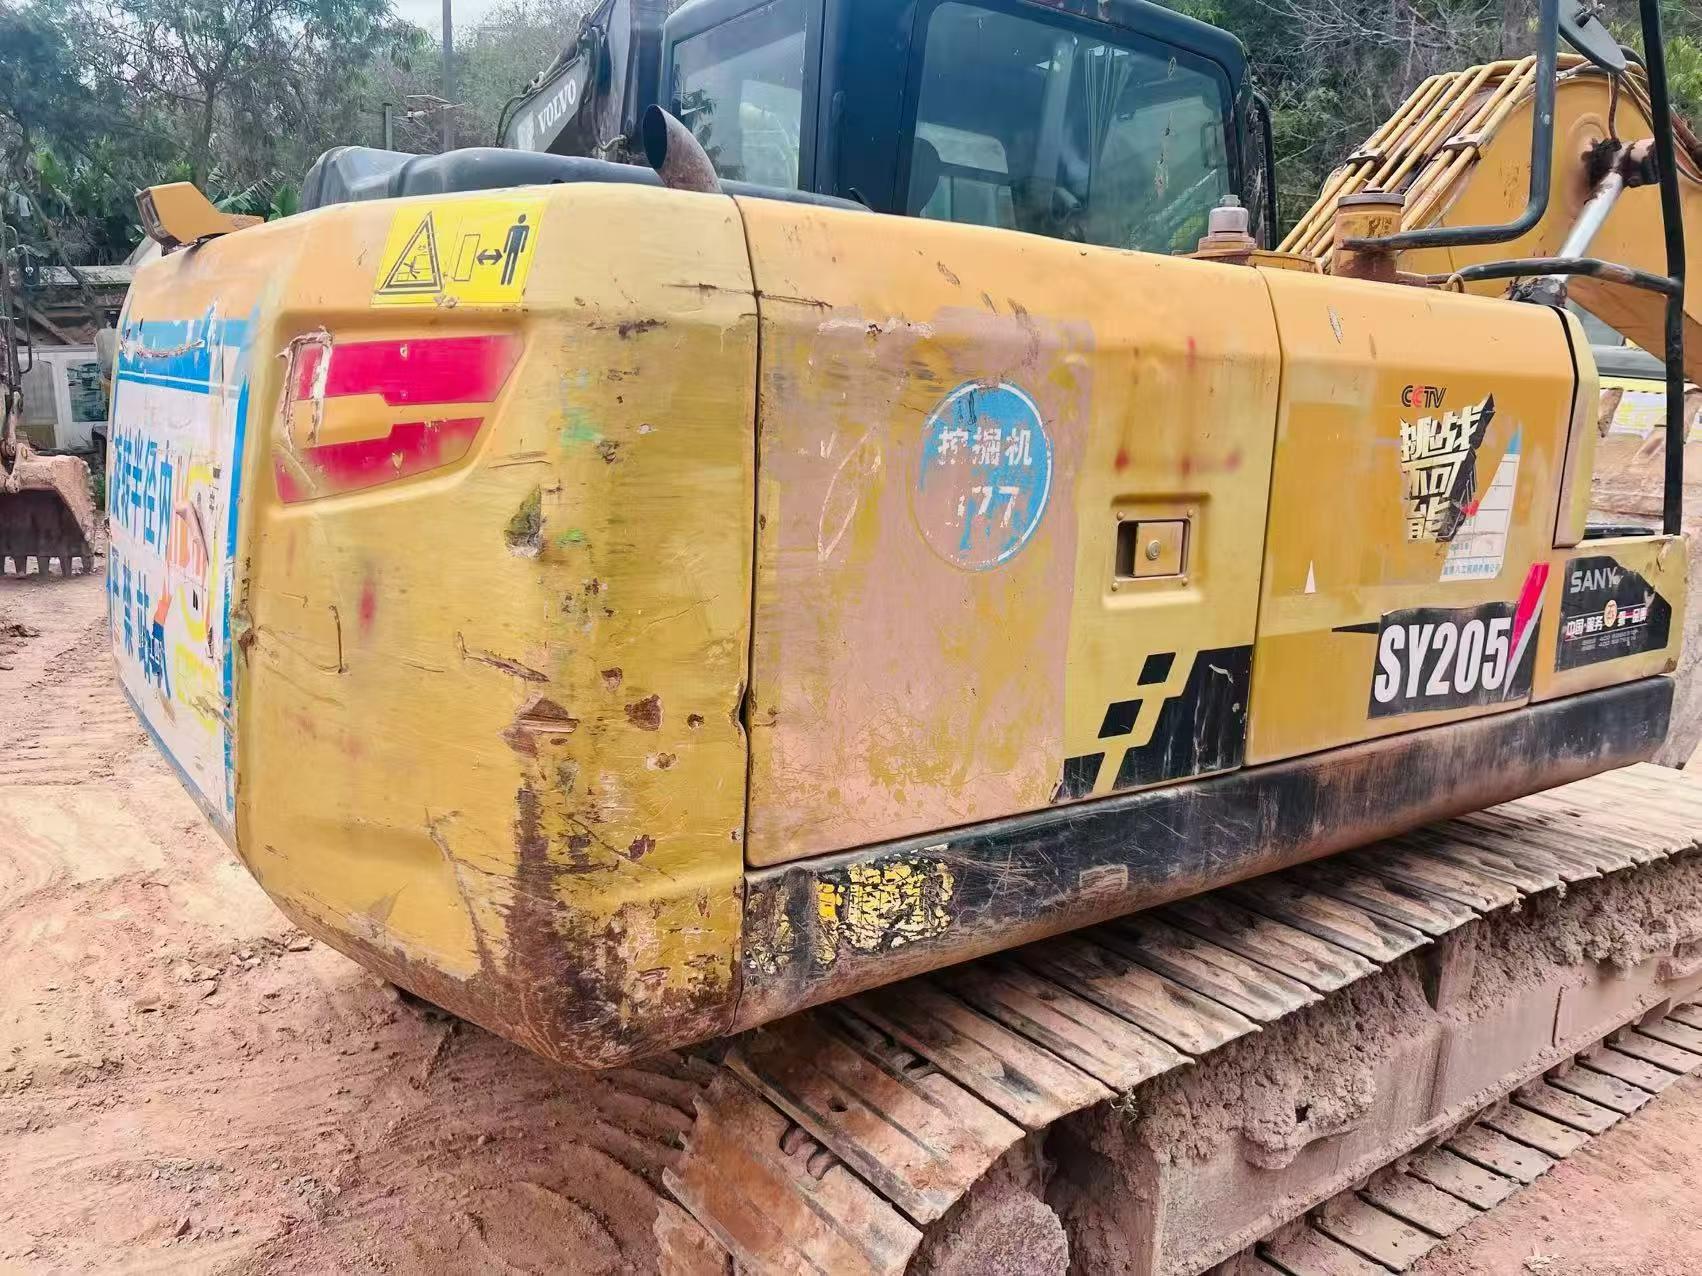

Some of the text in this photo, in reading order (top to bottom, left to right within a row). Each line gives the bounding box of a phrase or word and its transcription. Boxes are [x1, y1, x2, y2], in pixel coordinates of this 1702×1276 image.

[538, 79, 576, 134] VOLVO
[1402, 385, 1446, 408] CCTV
[938, 427, 1032, 465] 挖掘机
[1400, 393, 1493, 461] 挑战
[1570, 567, 1617, 593] SANY
[1374, 617, 1511, 702] SY205
